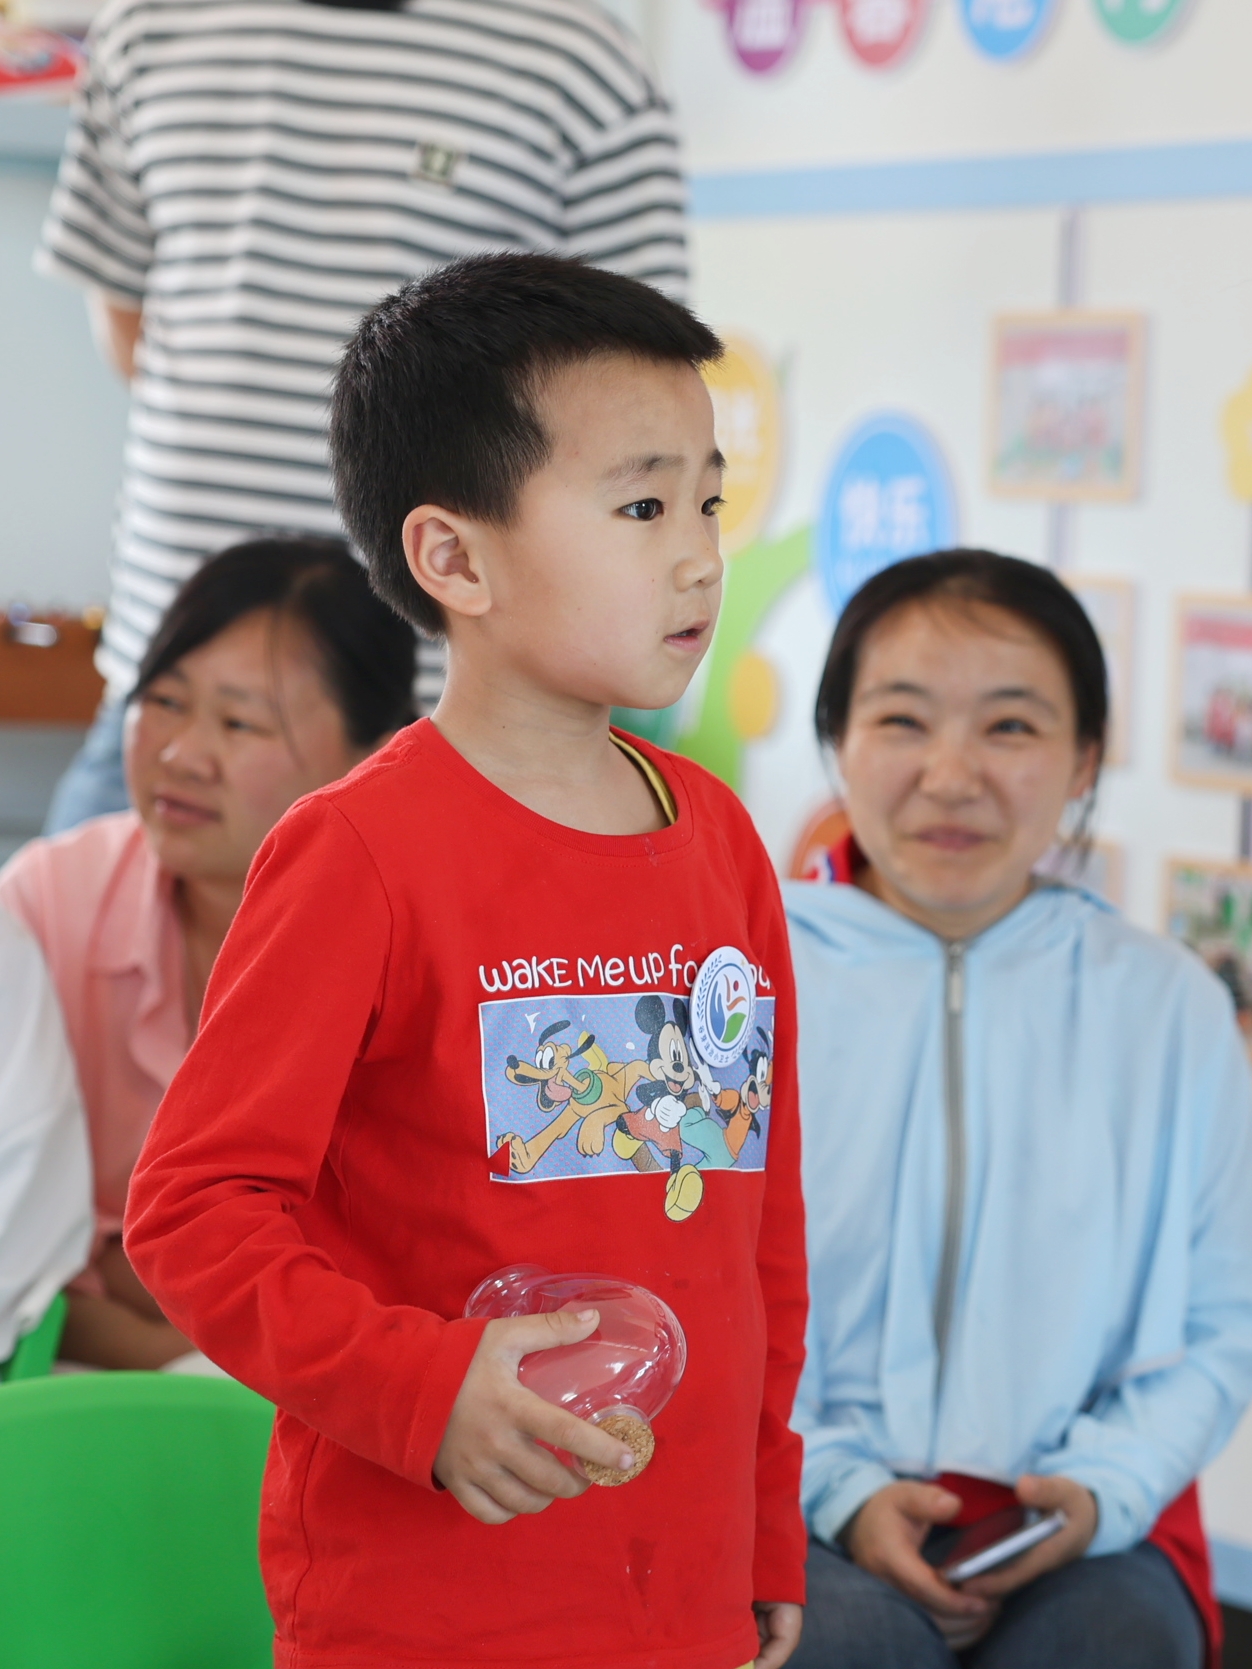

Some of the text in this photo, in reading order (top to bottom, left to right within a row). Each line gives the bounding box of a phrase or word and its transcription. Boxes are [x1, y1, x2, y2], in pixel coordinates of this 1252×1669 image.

[577, 954, 625, 987] Me
[629, 952, 665, 985] up
[669, 943, 698, 988] fo
